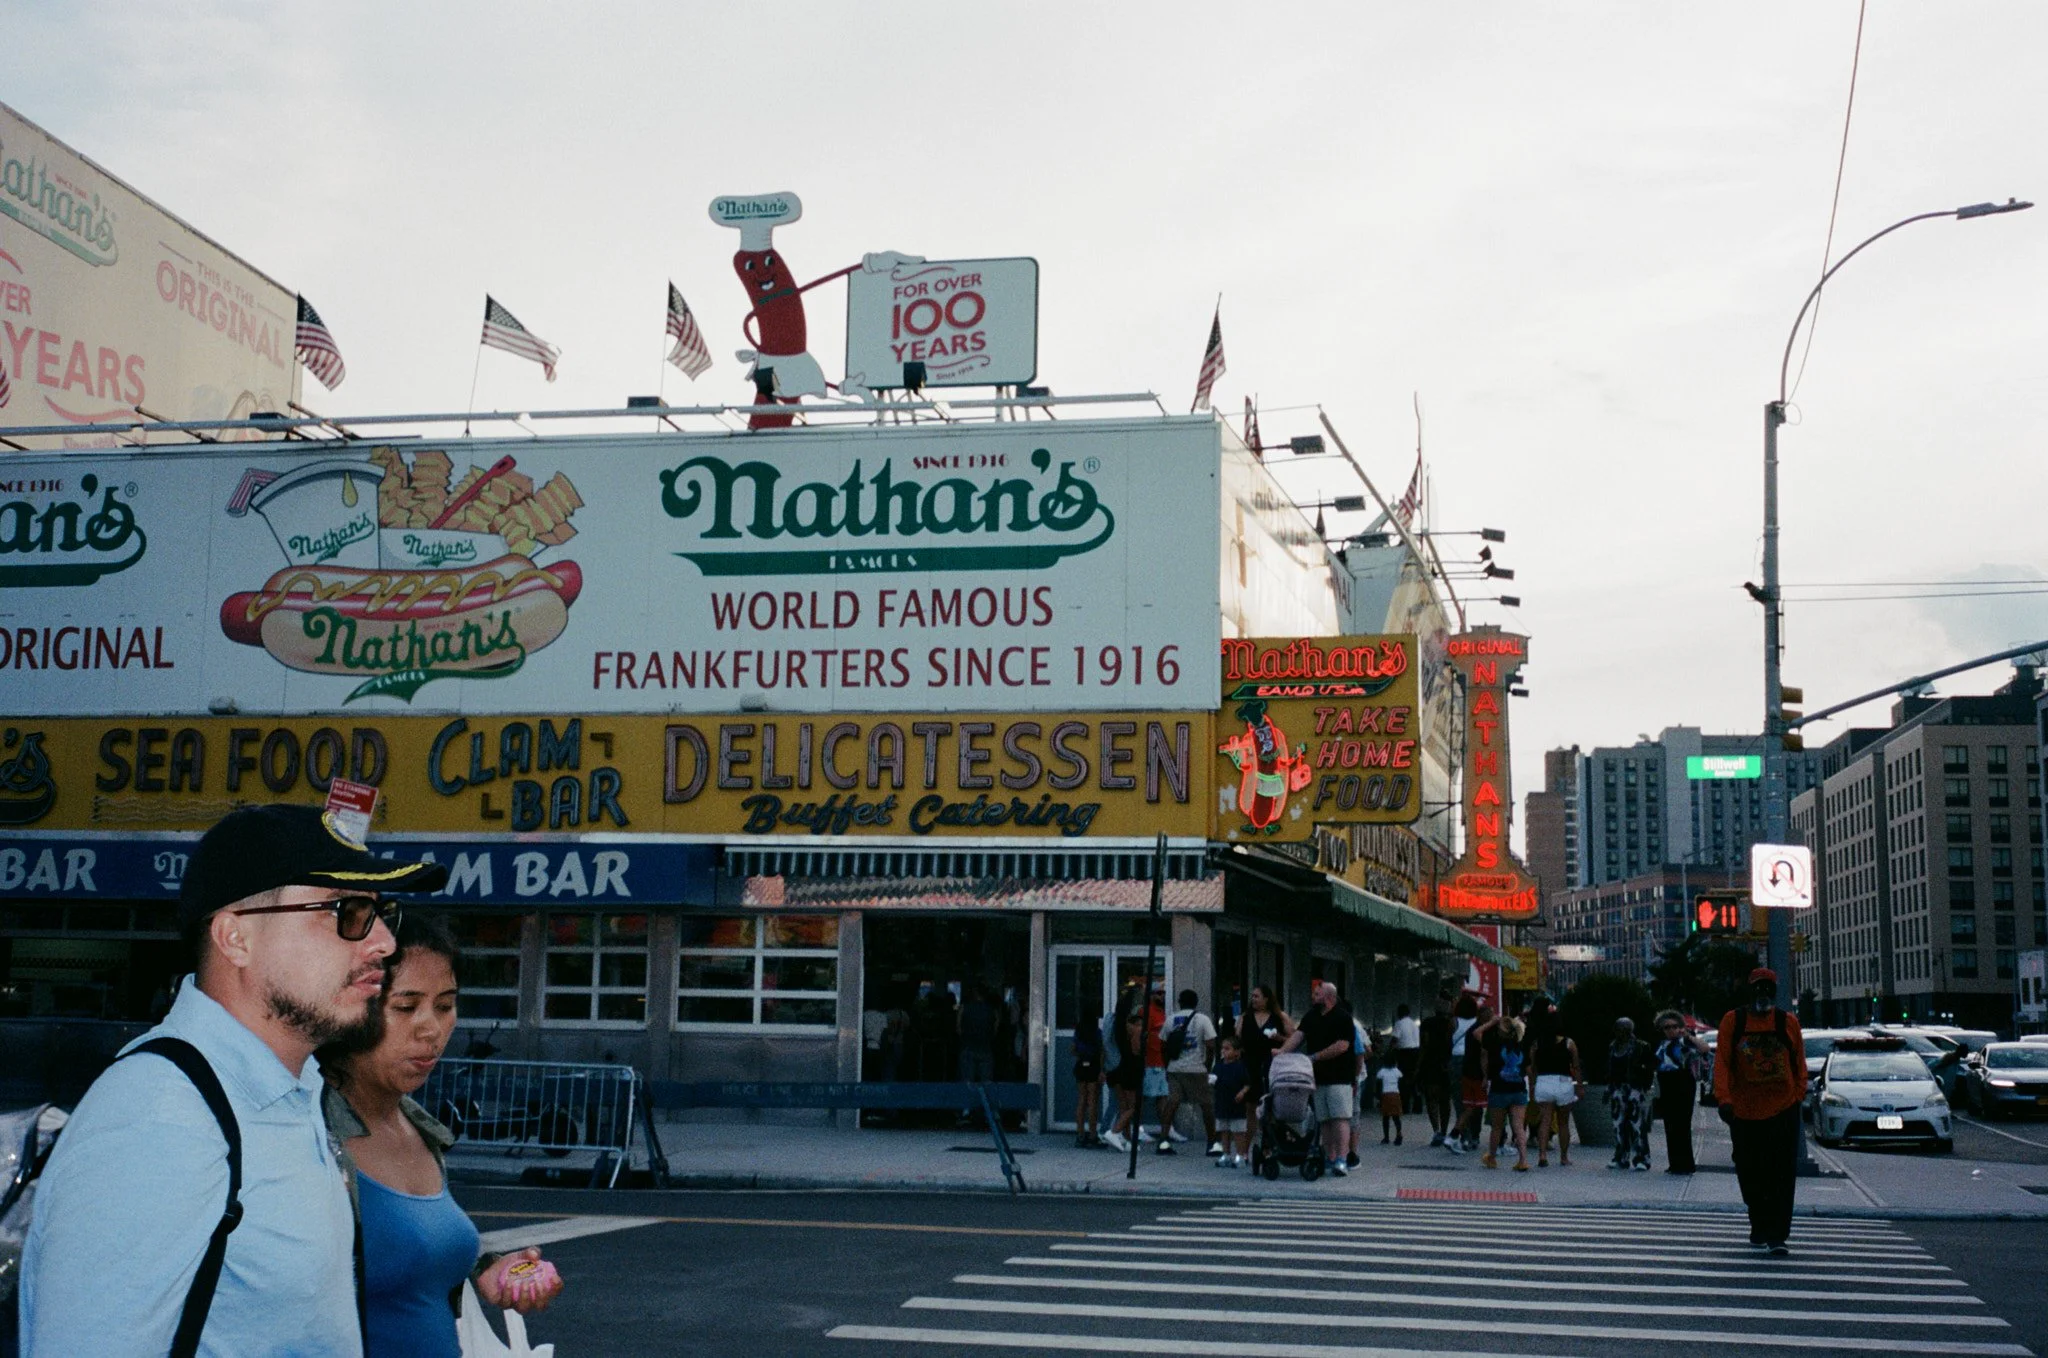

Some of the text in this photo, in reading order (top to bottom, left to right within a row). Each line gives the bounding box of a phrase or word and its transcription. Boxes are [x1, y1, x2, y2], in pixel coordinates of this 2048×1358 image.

[0, 155, 114, 251] athan's
[717, 198, 789, 215] Nathan's
[893, 273, 982, 300] FOR OVER
[156, 260, 286, 370] ORIGINAL
[892, 291, 986, 340] 100
[4, 320, 146, 405] YEARS
[890, 331, 987, 363] YEARS
[913, 454, 1010, 470] SINCE 1916
[658, 448, 1105, 540] Nathan's
[288, 511, 374, 558] Nathan's
[403, 533, 476, 560] Nathan's
[710, 586, 1053, 631] WORLD FAMOUS
[302, 605, 519, 670] Nathan's
[1221, 638, 1407, 681] Nathan's
[1449, 637, 1523, 656] ORIGINAL
[593, 644, 1180, 690] FRANKFURTERS SINCE 1916
[1314, 706, 1410, 735] TAKE
[96, 726, 207, 793] SEA
[226, 726, 389, 793] FOOD
[429, 717, 582, 796] CLAM
[662, 721, 1191, 804] DELICATESSEN
[1317, 740, 1415, 768] HOME
[1473, 660, 1500, 868] NATHANS
[511, 766, 630, 832] BAR
[1313, 773, 1412, 812] FOOD
[742, 794, 1101, 837] Buffet Catering
[0, 848, 97, 892] BAR
[512, 850, 632, 897] BAR
[1721, 904, 1737, 929] 11
